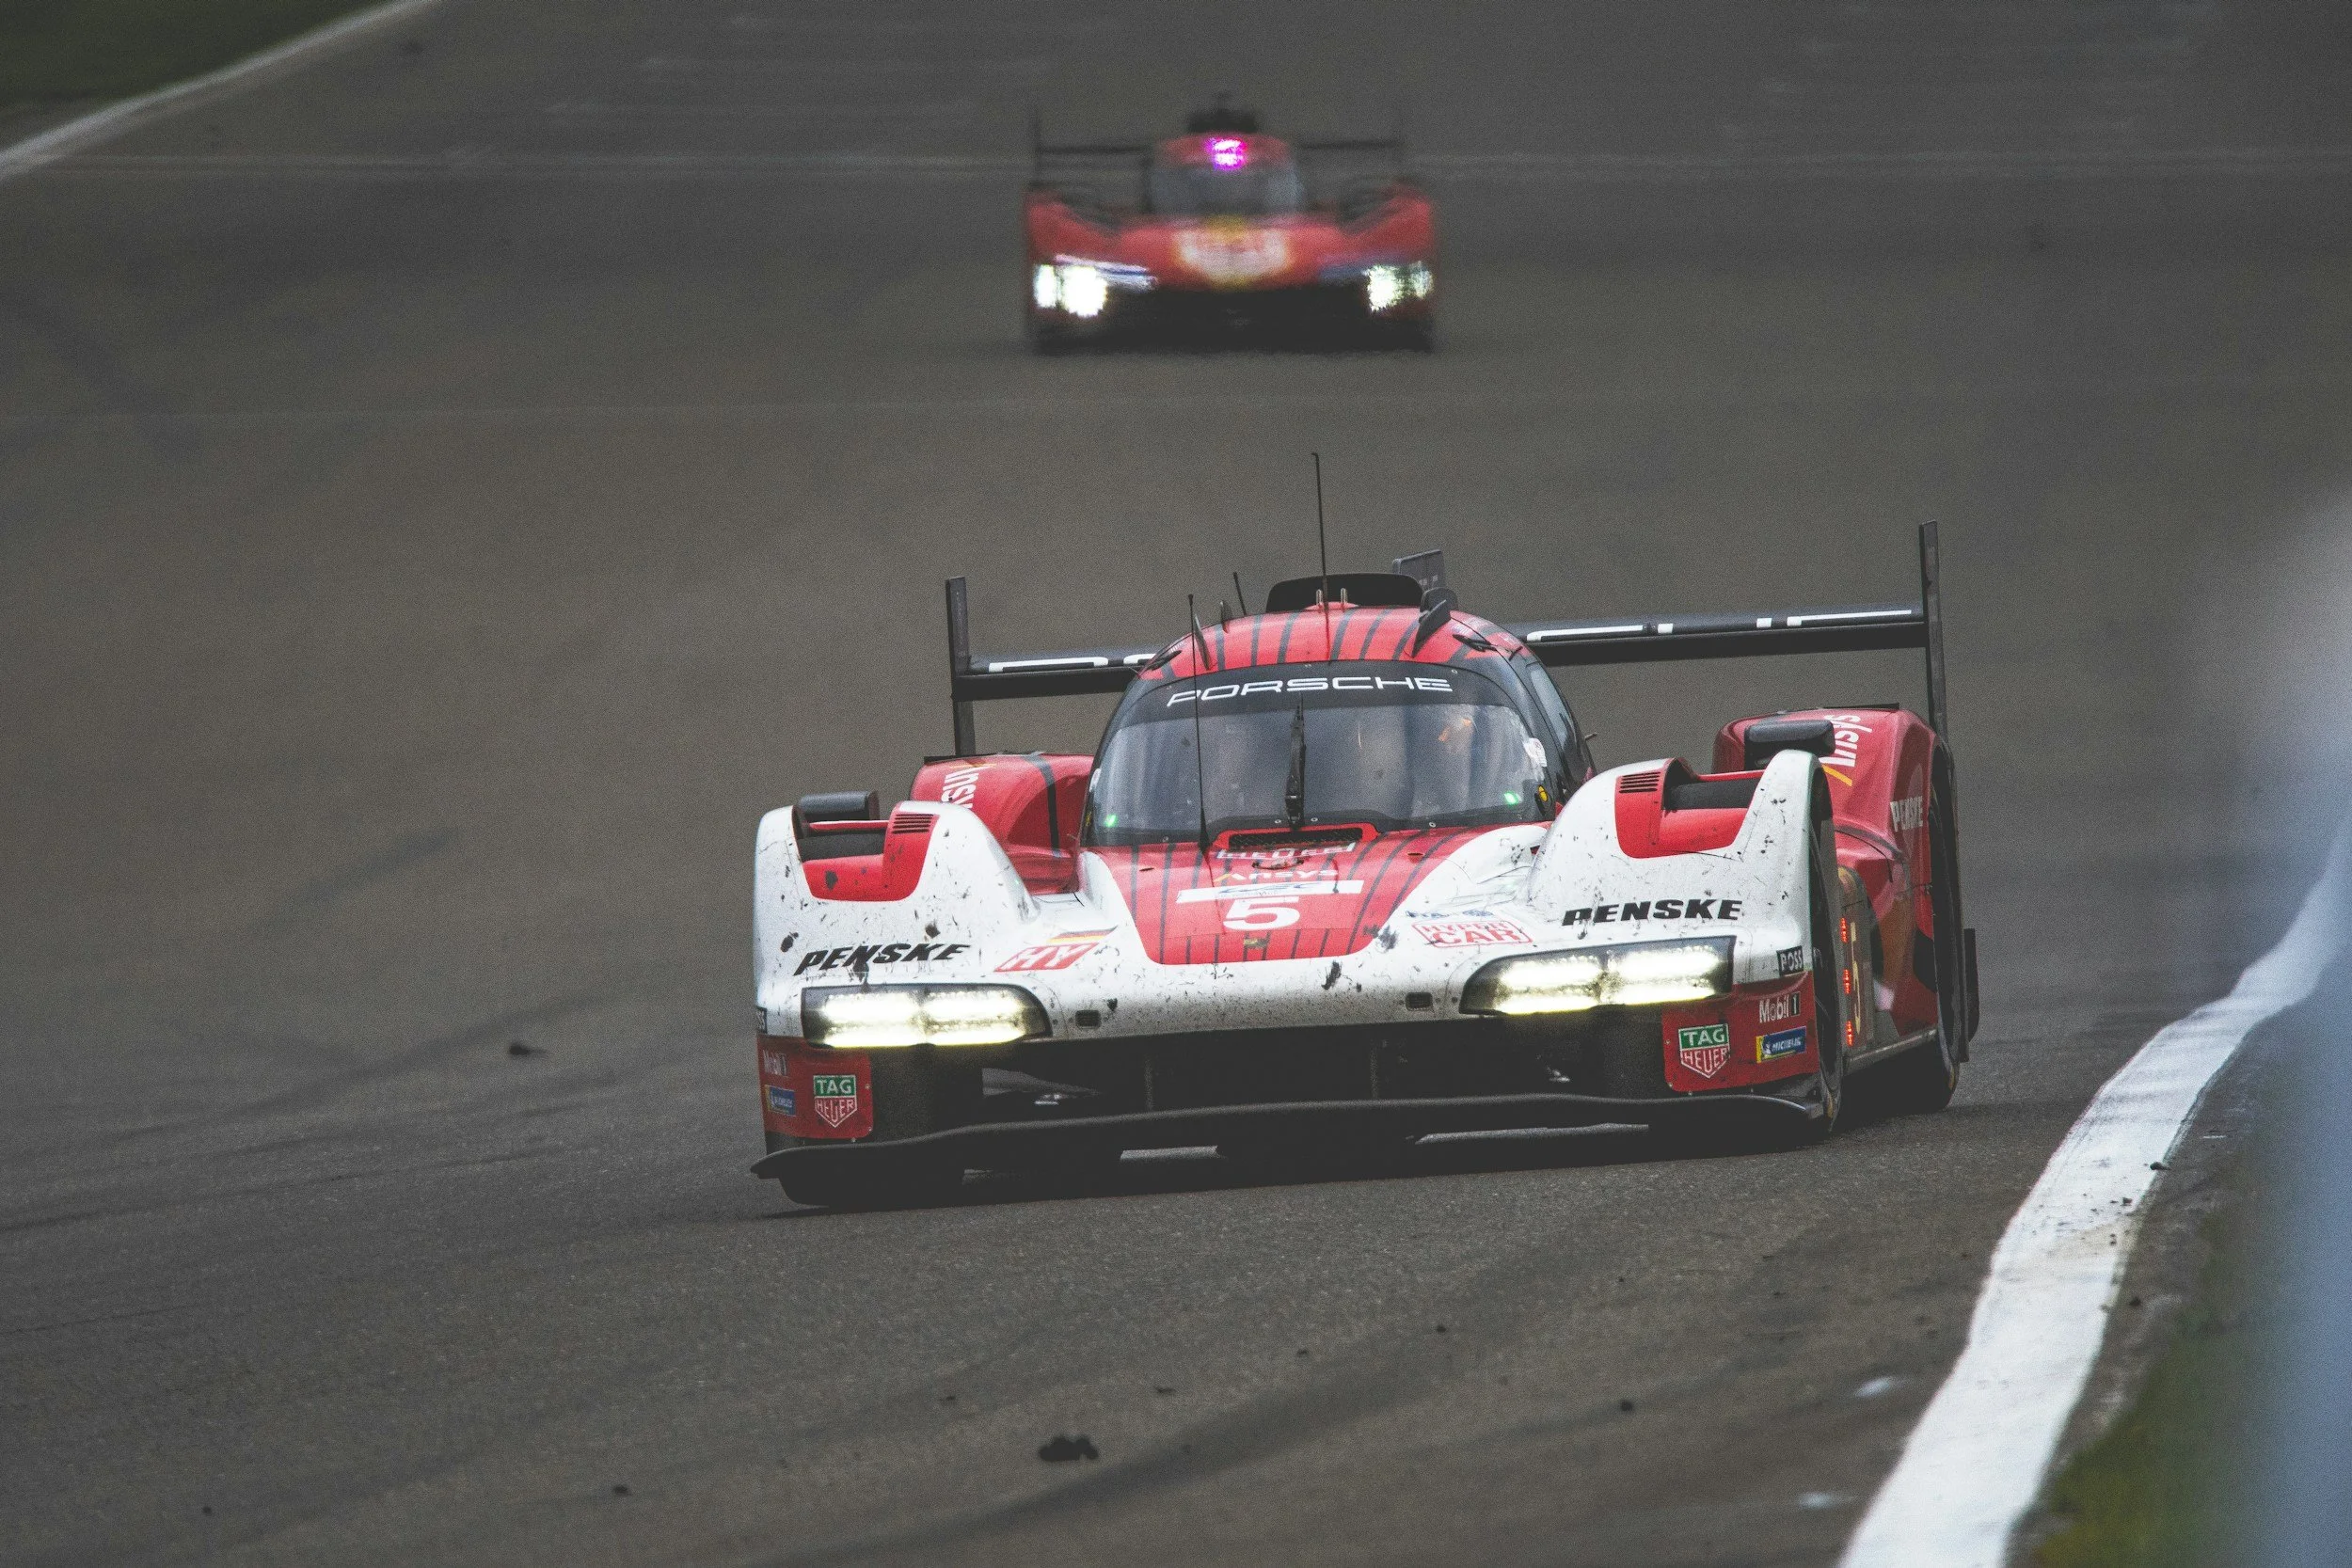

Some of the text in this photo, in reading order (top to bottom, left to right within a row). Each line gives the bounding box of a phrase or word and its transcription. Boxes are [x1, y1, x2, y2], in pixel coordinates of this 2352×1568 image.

[1167, 676, 1454, 706] PORSCHE
[1223, 895, 1301, 931] 5
[1561, 898, 1742, 927] PENSKE
[1433, 928, 1522, 944] CAR
[793, 942, 971, 975] PENSKE
[1758, 994, 1789, 1023] Mobil
[1684, 1028, 1725, 1046] TAG
[1684, 1047, 1729, 1073] HEUER
[817, 1079, 852, 1094] TAG
[817, 1099, 854, 1123] HEUER
